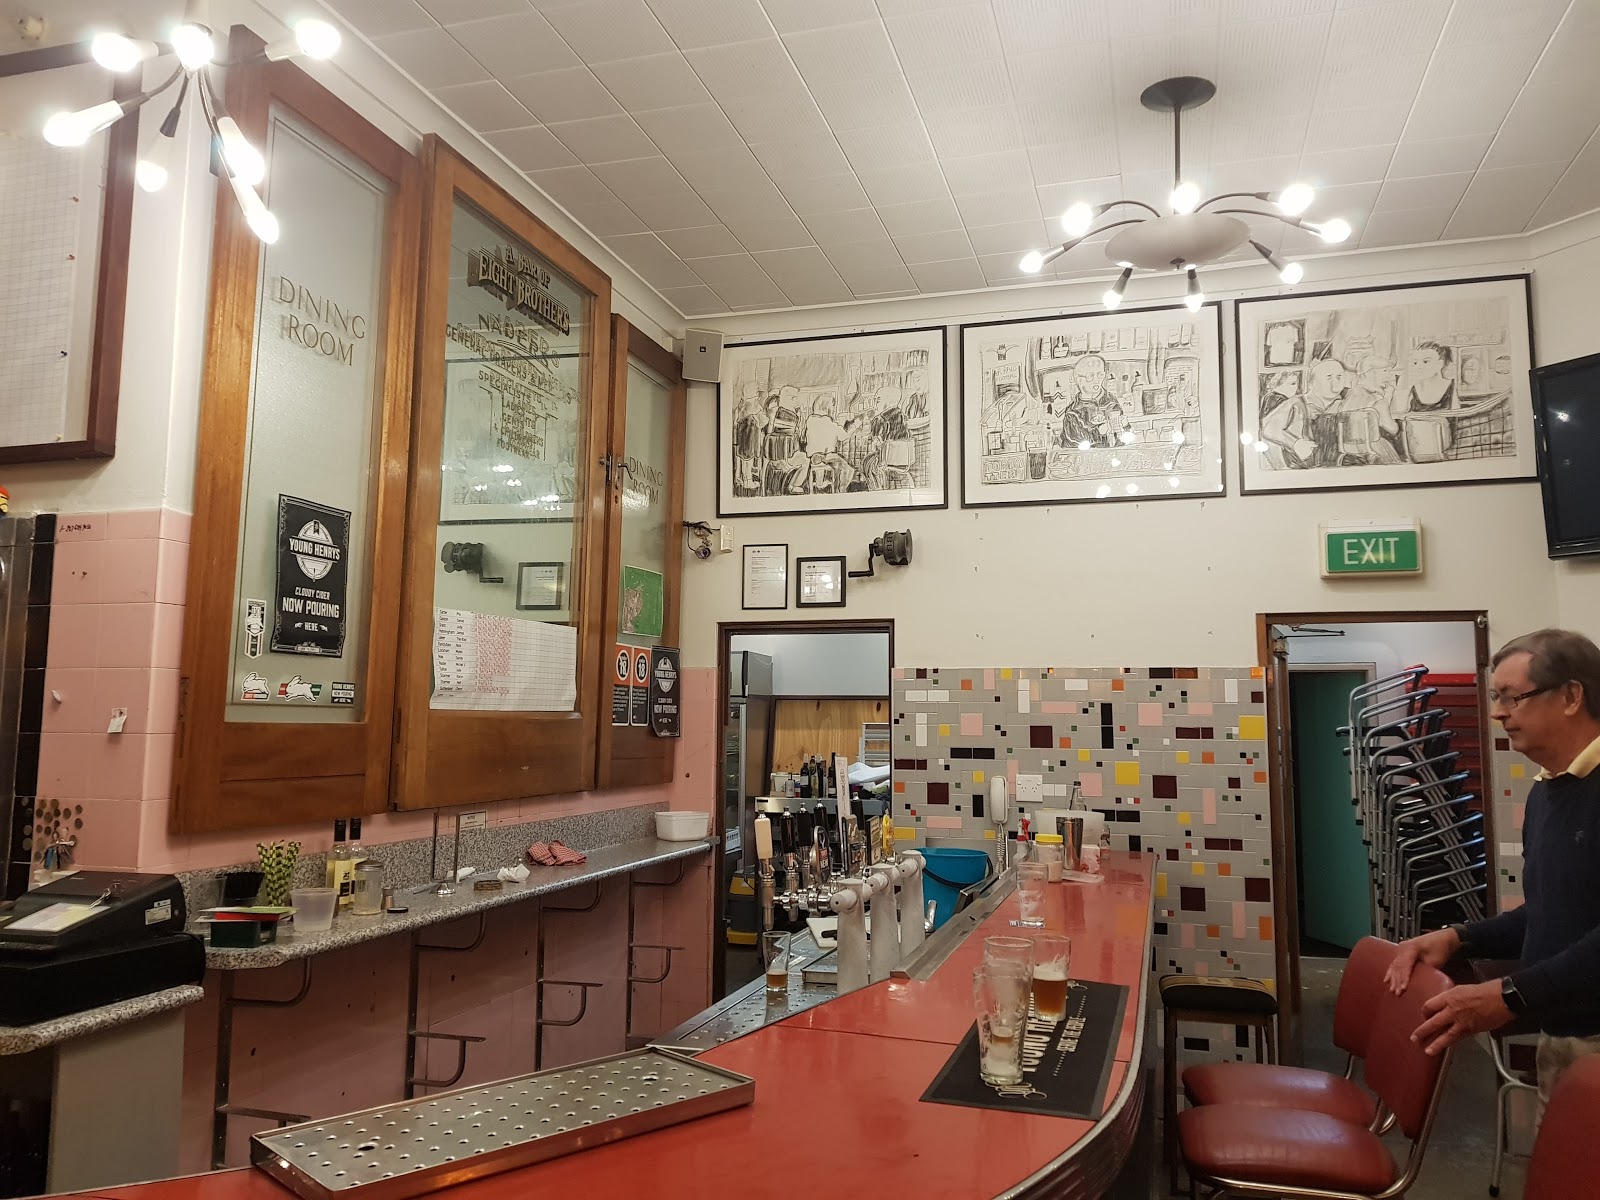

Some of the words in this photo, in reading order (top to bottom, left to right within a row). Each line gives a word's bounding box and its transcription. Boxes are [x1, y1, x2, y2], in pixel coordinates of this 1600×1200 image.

[505, 243, 515, 264] A
[517, 251, 539, 280] BAR
[540, 268, 551, 289] OF
[279, 275, 366, 339] DINING
[479, 253, 515, 297] EIGHT
[517, 277, 570, 336] BROTHERS
[288, 313, 354, 366] ROOM
[629, 456, 663, 486] DINING
[633, 478, 659, 504] ROOM
[289, 537, 313, 555] YOUNG
[314, 544, 341, 560] HENRYS
[1343, 537, 1399, 565] EXIT
[294, 586, 315, 598] CLOUDY
[315, 589, 331, 600] CIDER
[282, 597, 304, 614] NOW
[305, 600, 340, 619] POURING
[304, 621, 319, 632] HERE
[638, 663, 646, 678] 18
